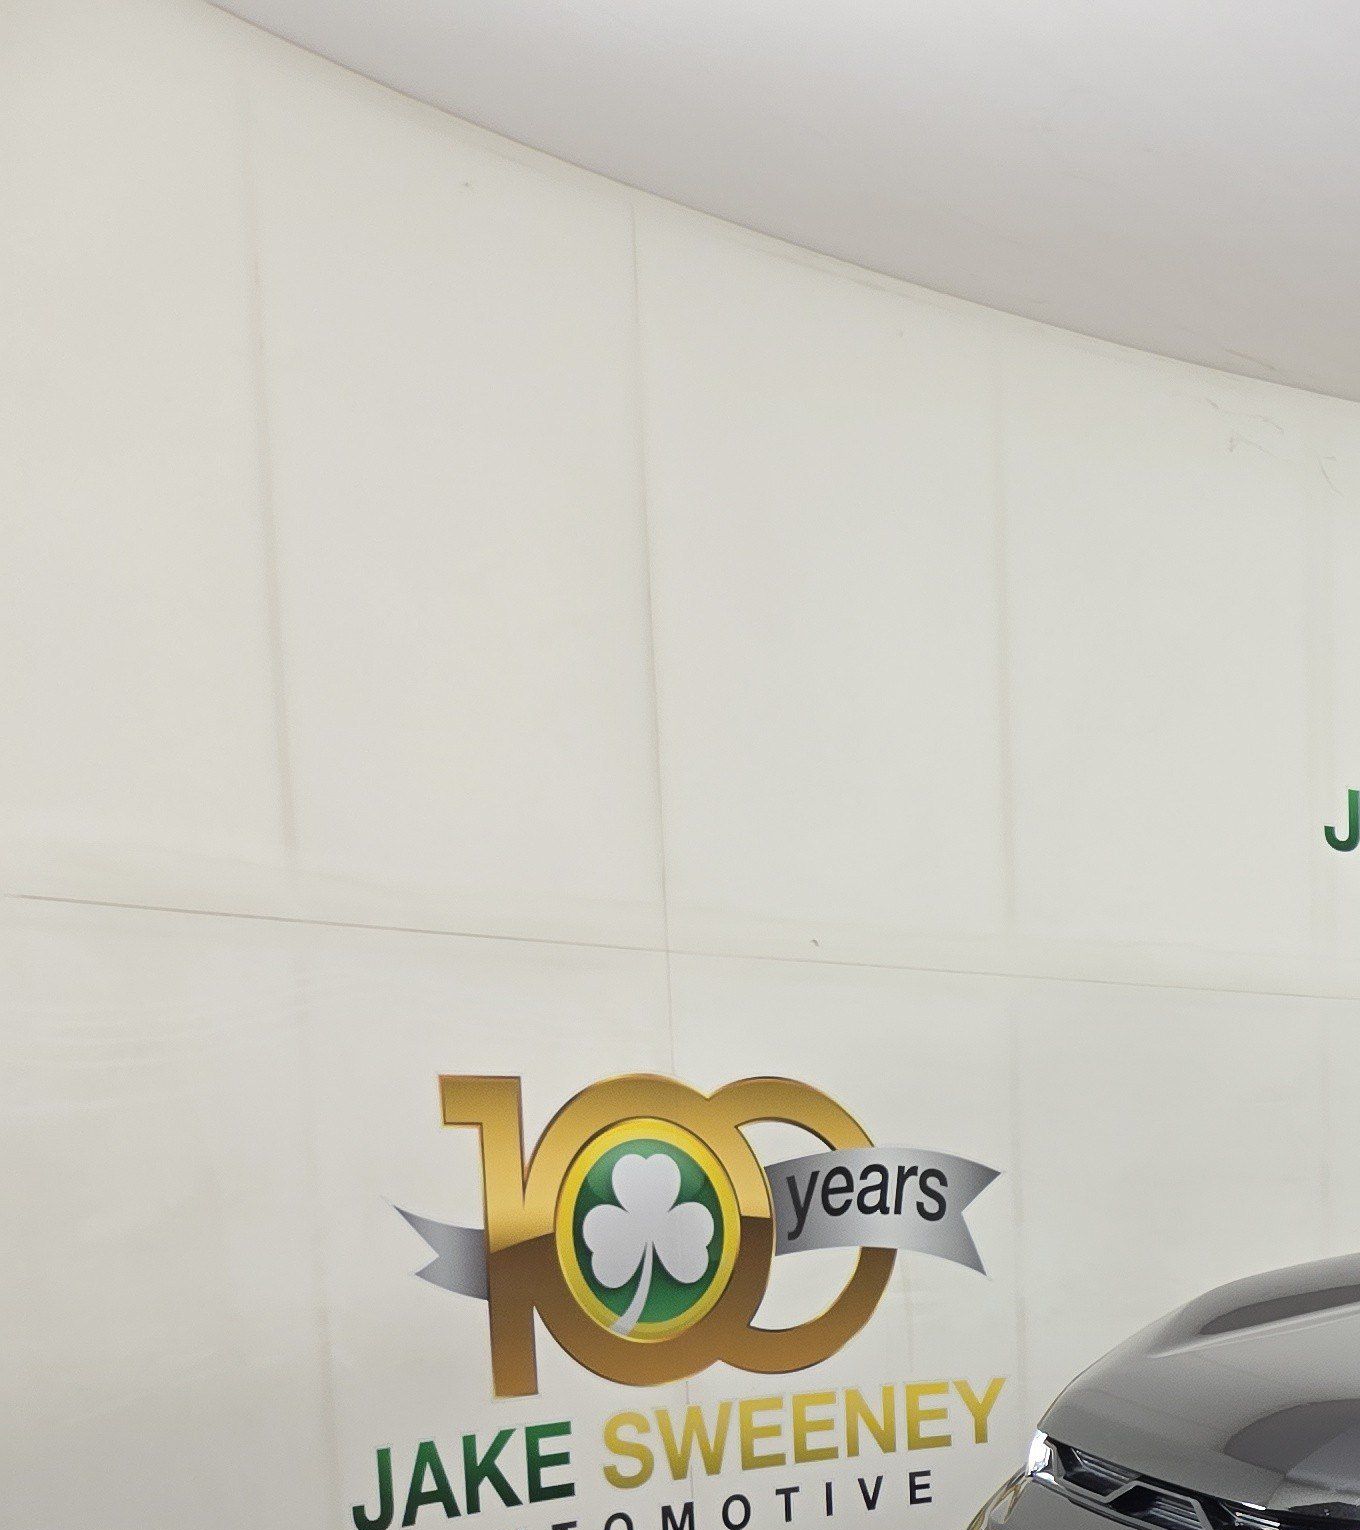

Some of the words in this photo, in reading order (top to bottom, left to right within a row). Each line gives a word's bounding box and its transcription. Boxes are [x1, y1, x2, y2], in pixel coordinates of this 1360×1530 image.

[438, 1074, 897, 1397] 100
[785, 1163, 949, 1241] years
[602, 1377, 1006, 1490] SWEENEY
